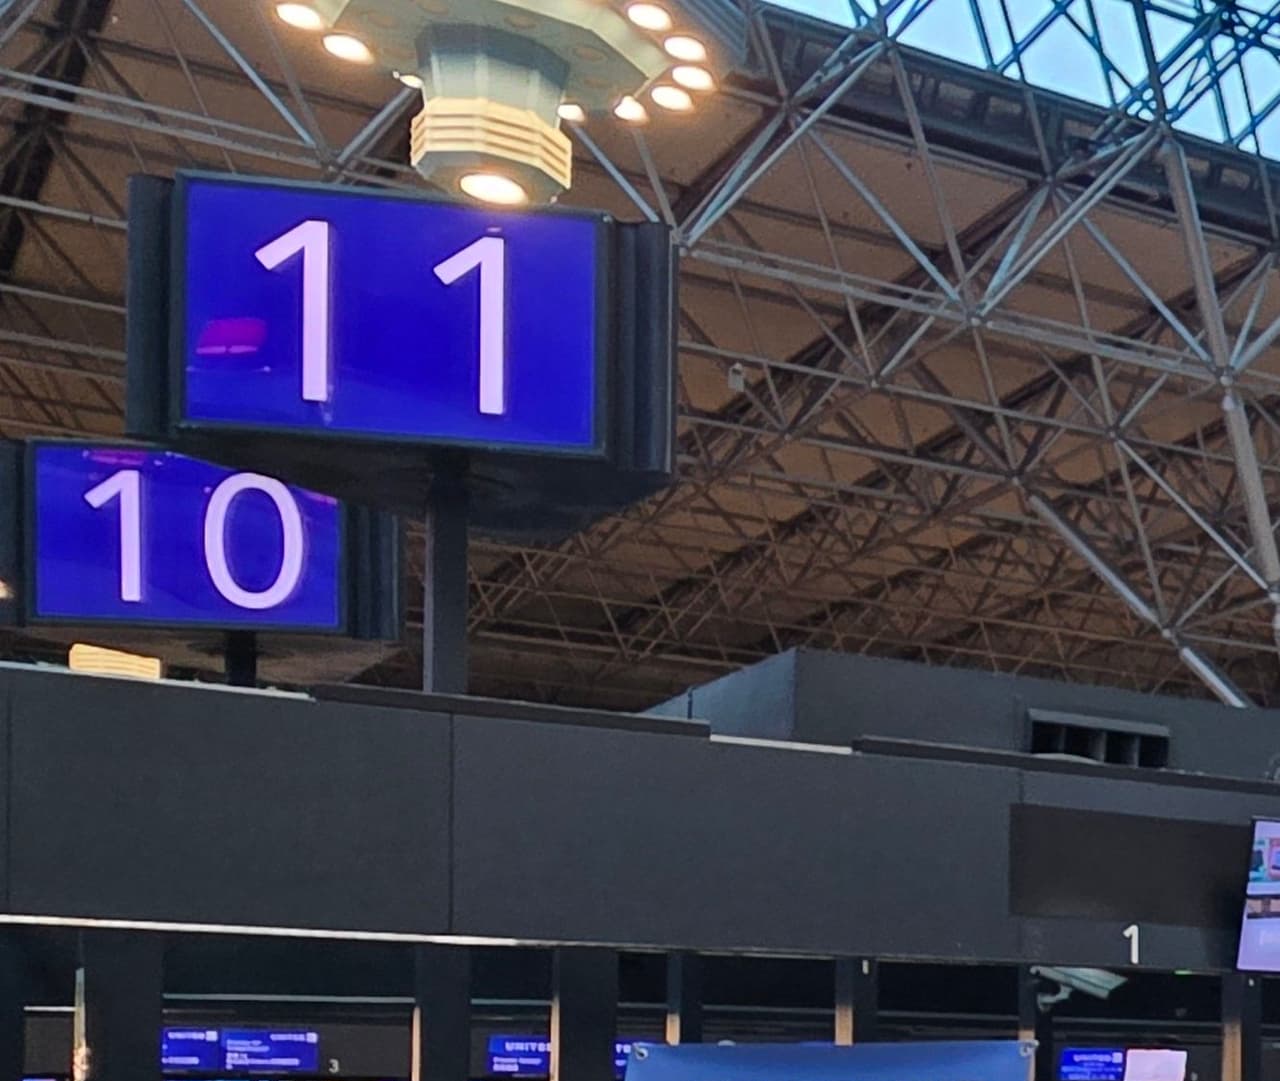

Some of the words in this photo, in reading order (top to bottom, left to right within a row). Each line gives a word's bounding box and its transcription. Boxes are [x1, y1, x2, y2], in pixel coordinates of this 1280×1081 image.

[254, 219, 505, 415] 11
[84, 470, 305, 610] 10
[1123, 925, 1141, 963] 1
[329, 1059, 340, 1073] 3
